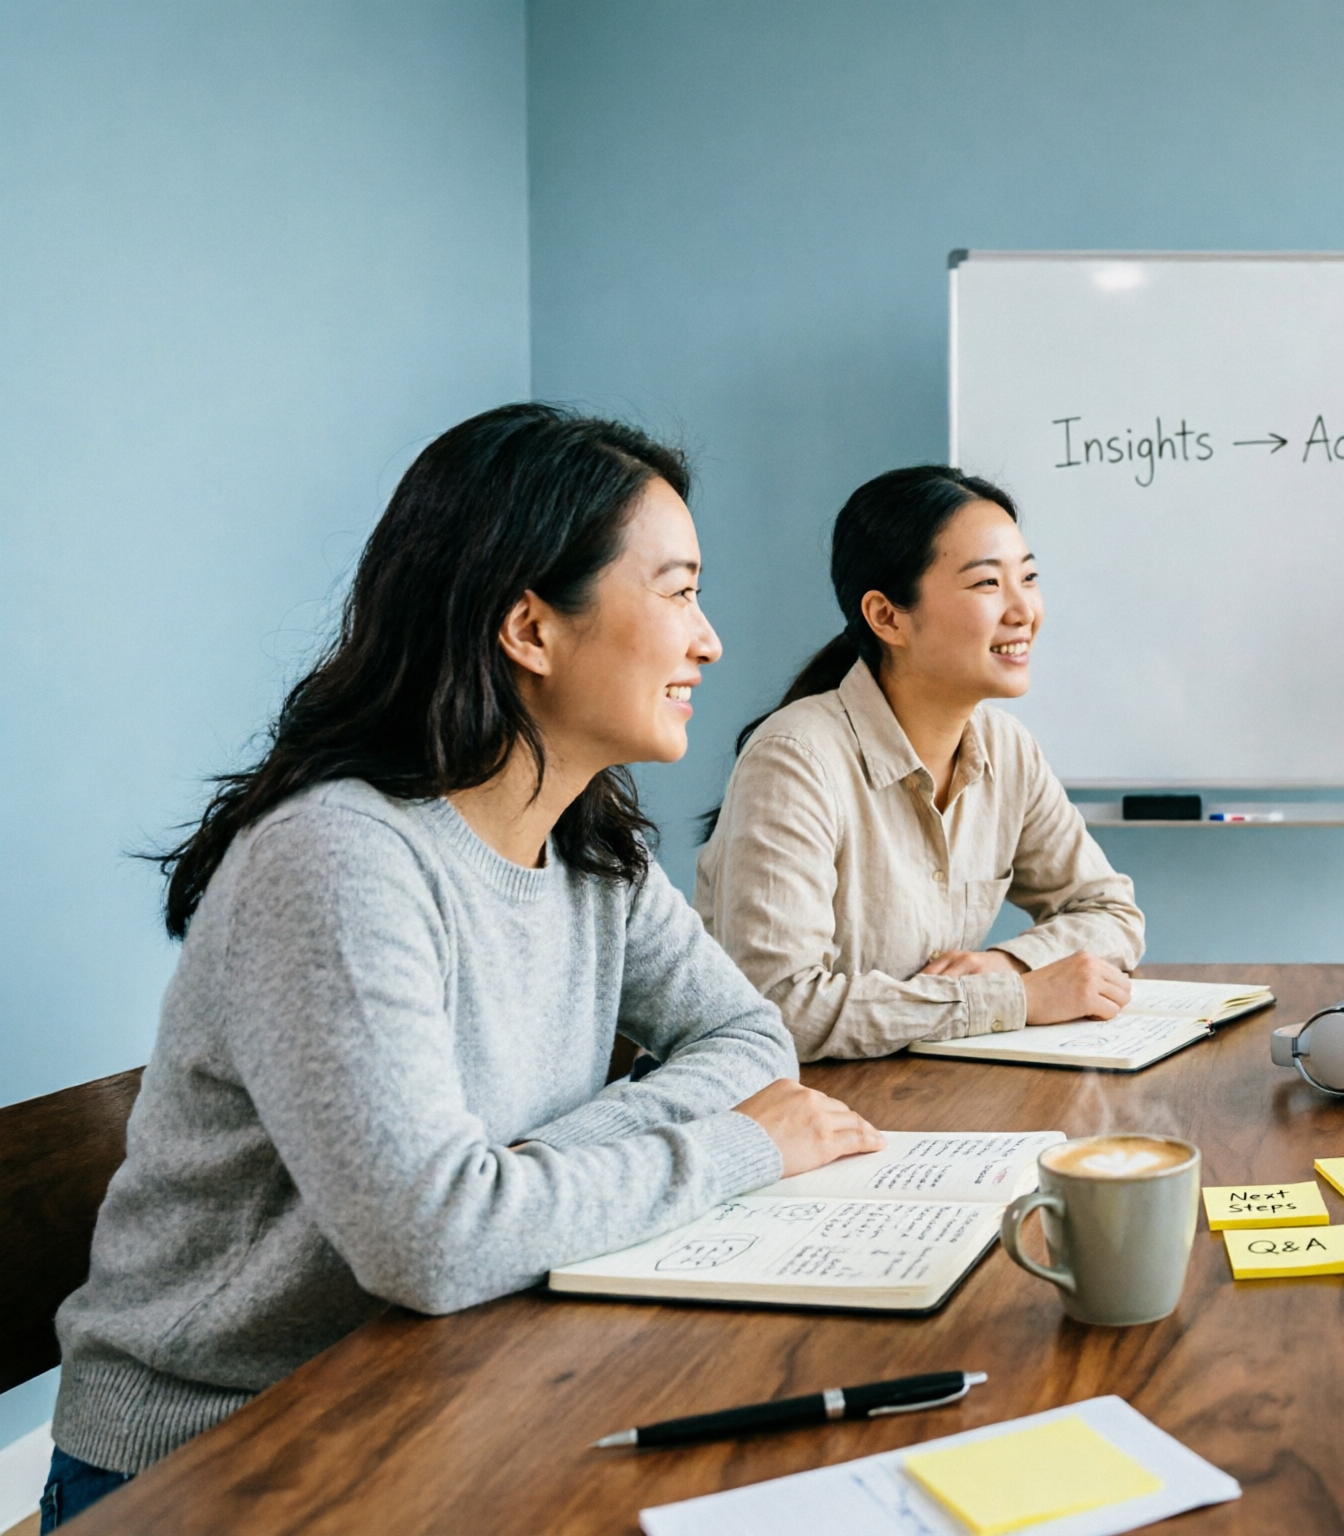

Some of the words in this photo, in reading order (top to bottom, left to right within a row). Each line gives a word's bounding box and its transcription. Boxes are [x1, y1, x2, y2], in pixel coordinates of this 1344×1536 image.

[1052, 416, 1213, 487] Insights
[1230, 1189, 1290, 1202] Next
[1229, 1201, 1297, 1214] Steps
[1247, 1237, 1326, 1254] Q&A
